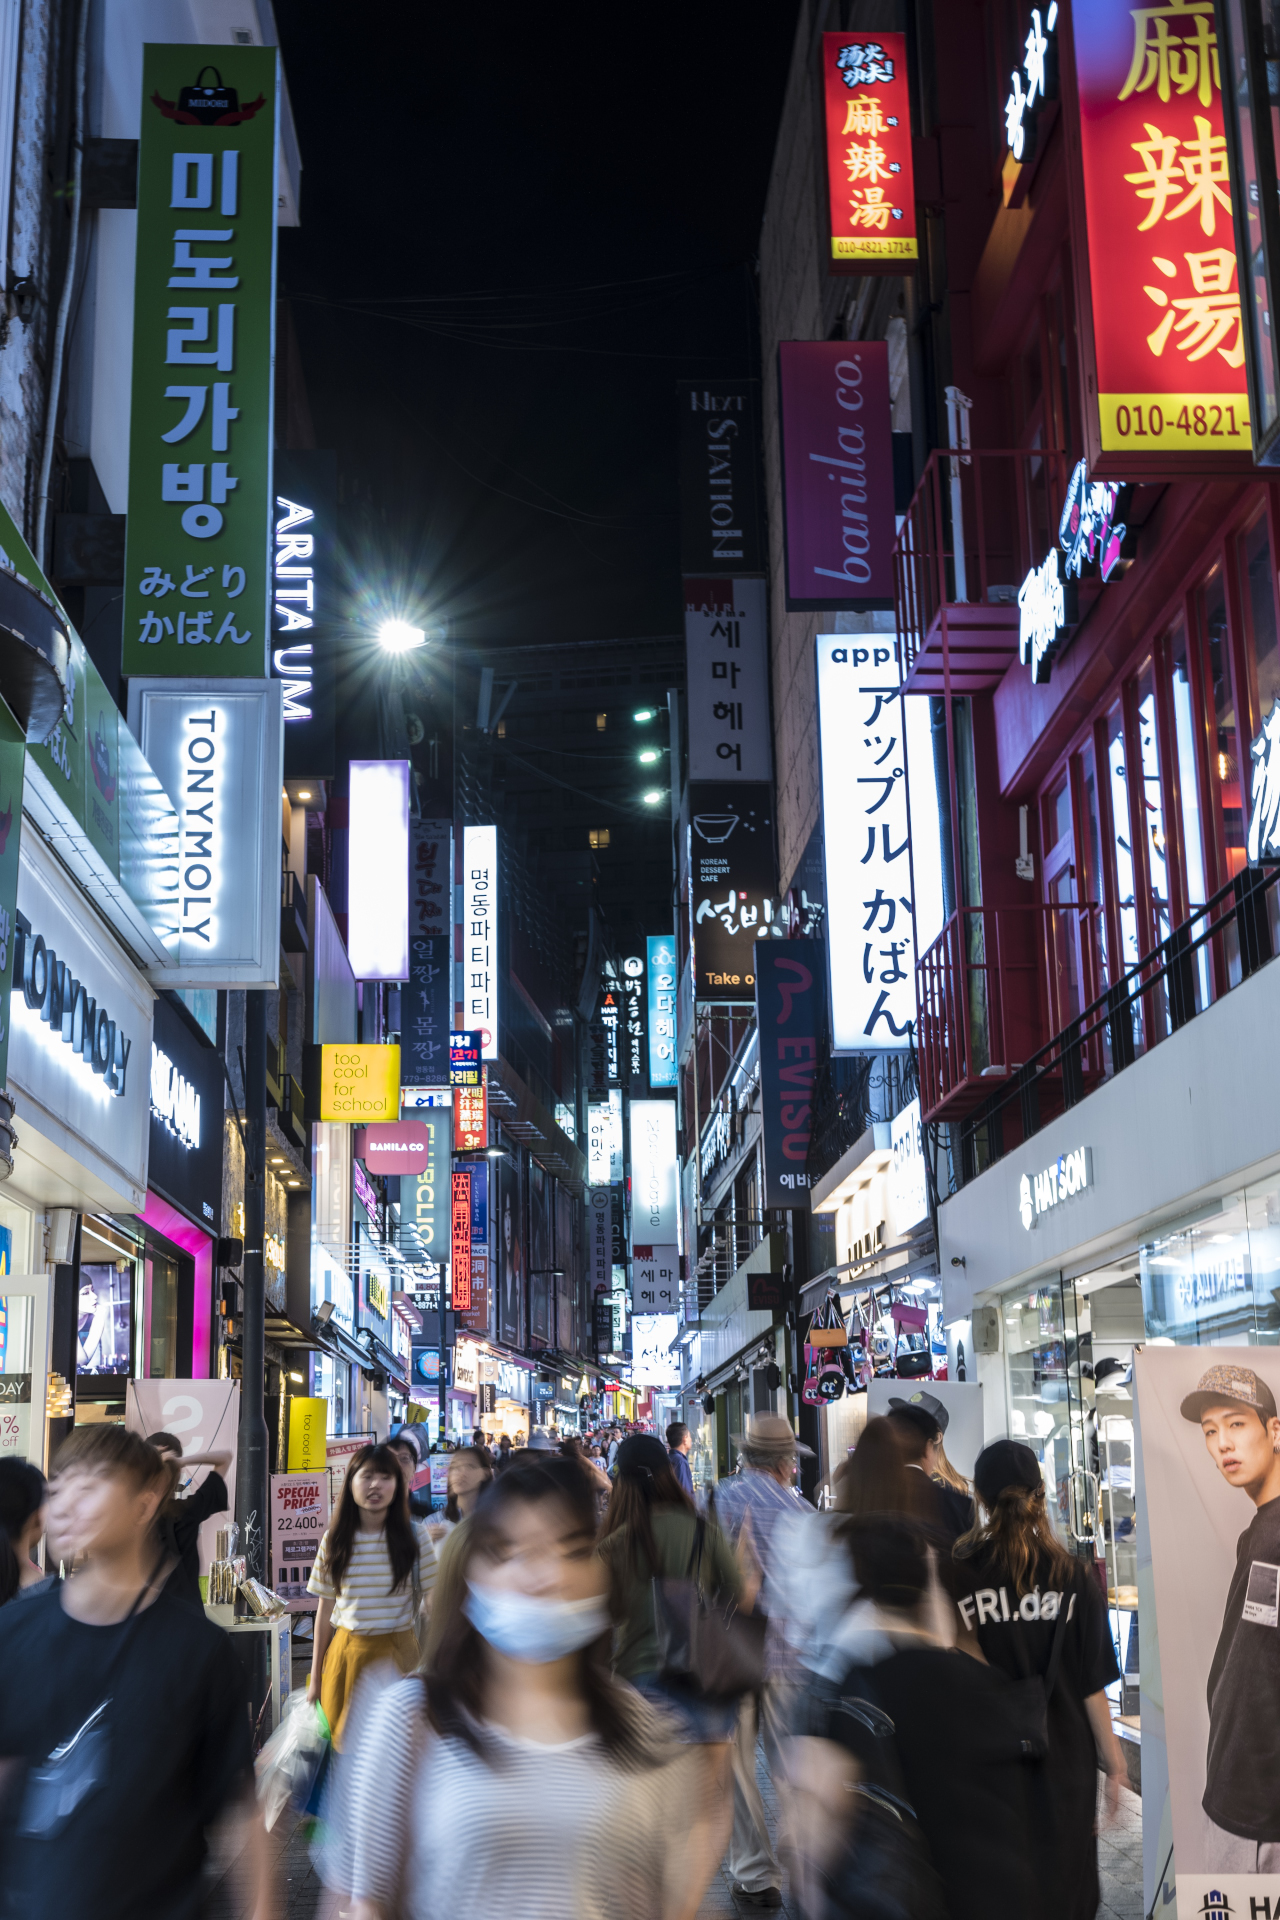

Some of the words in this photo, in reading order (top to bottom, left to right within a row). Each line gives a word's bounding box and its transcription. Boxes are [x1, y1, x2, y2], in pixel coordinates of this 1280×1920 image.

[188, 99, 229, 108] MIDORI
[841, 94, 894, 231] 麻辣湯
[161, 150, 241, 538] 미도리가방
[707, 418, 743, 558] STATION
[808, 426, 872, 584] banila
[138, 565, 247, 599] みどり
[138, 611, 252, 646] かばん
[710, 621, 743, 771] 세마헤어
[182, 710, 216, 943] TONYMOLY
[470, 868, 491, 1019] 명동파티파티
[412, 939, 440, 984] 얼짱
[706, 973, 740, 985] Take
[656, 974, 676, 1063] 오다헤어
[412, 1016, 442, 1061] 몸짱
[334, 1053, 360, 1065] too
[333, 1065, 368, 1078] cool
[404, 1075, 447, 1083] 779-8286
[334, 1082, 355, 1096] for
[777, 1037, 817, 1160] EVISU
[333, 1097, 387, 1111] school
[370, 1143, 408, 1151] BANILA
[409, 1143, 424, 1151] CO
[465, 1134, 480, 1146] 3F
[304, 1414, 312, 1431] too
[2, 1436, 19, 1446] off
[303, 1433, 311, 1455] cool
[277, 1486, 320, 1499] SPECIAL
[283, 1498, 315, 1510] PRICE
